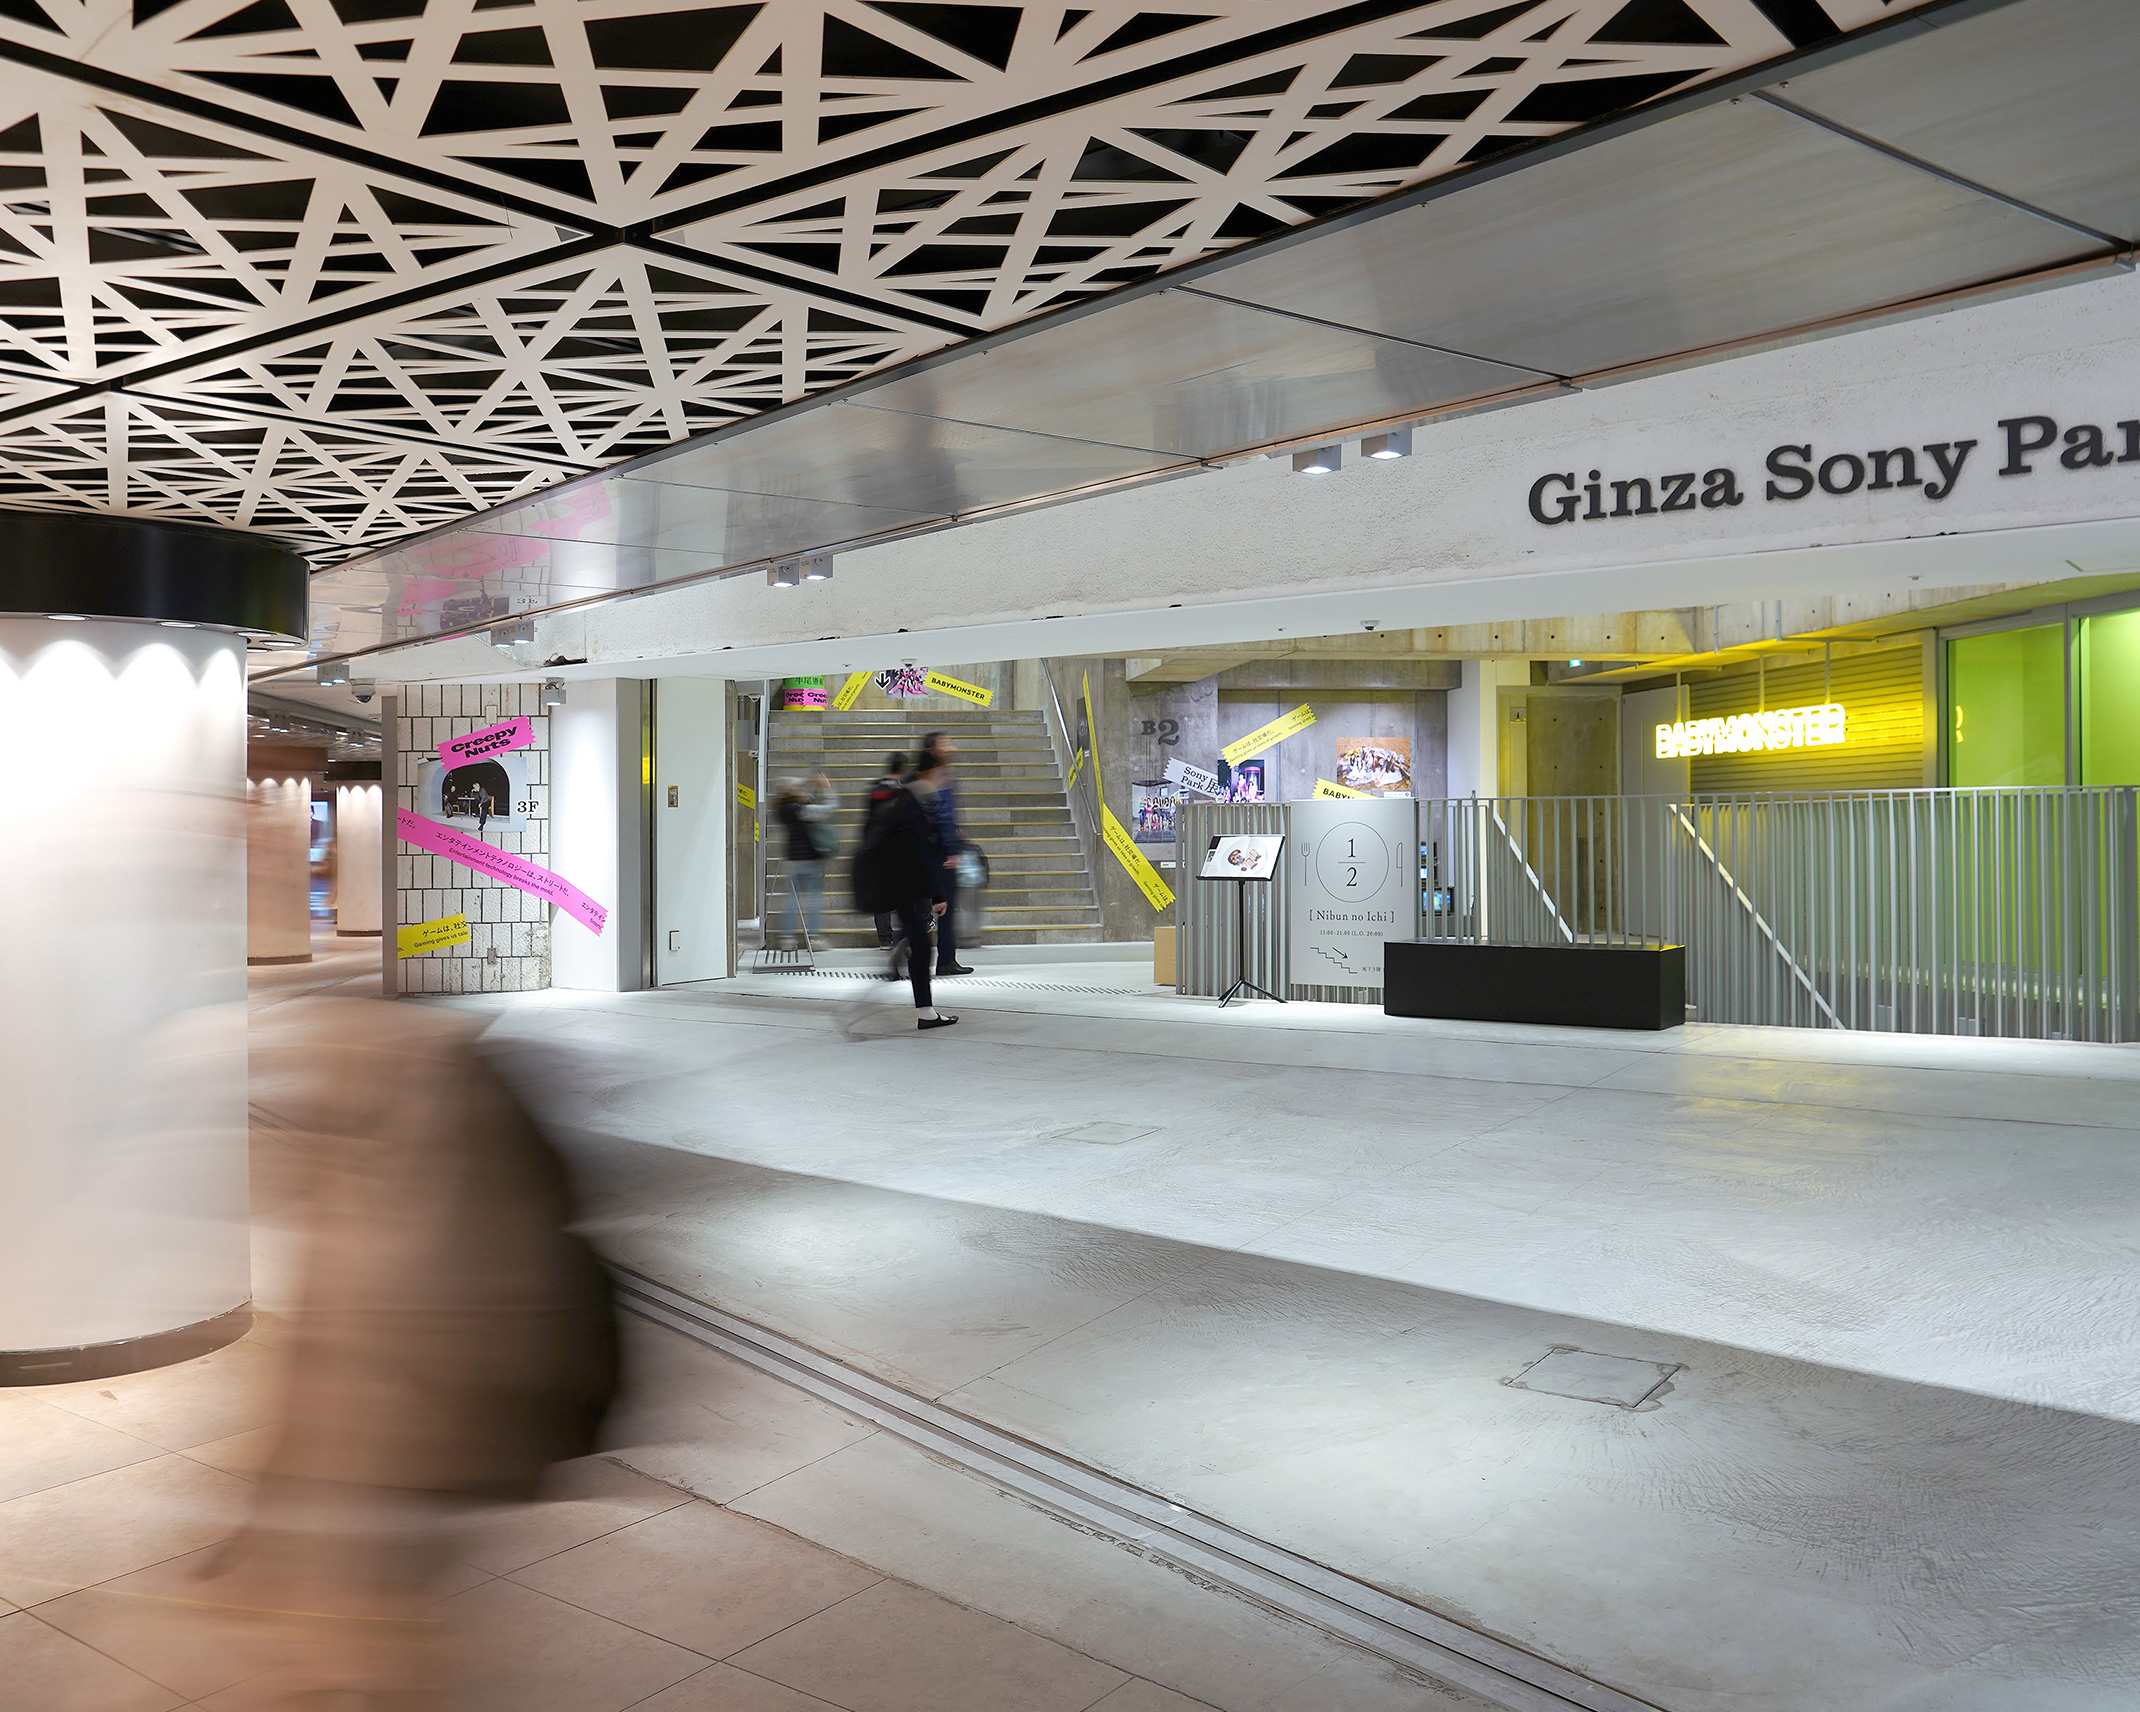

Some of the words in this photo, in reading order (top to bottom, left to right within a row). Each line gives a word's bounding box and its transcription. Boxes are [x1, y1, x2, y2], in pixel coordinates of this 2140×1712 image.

[1528, 470, 1744, 525] Ginza
[1766, 439, 1977, 501] Sony
[931, 677, 985, 700] BABYMONSTER
[451, 726, 517, 753] Creepy
[1141, 719, 1180, 746] B2
[1655, 703, 1847, 759] BABYMONSTER
[464, 739, 511, 758] Nuts
[1181, 776, 1204, 790] Park
[1184, 766, 1208, 782] Sony
[517, 801, 539, 813] 3F
[1348, 838, 1356, 858] 1
[448, 847, 484, 866] Entertainment
[484, 862, 513, 879] technology
[512, 874, 531, 885] breaks
[1346, 867, 1358, 886] 2
[1317, 910, 1348, 920] Nibun
[1367, 911, 1387, 921] Ichi
[413, 938, 434, 948] Gaming
[435, 934, 449, 943] gives
